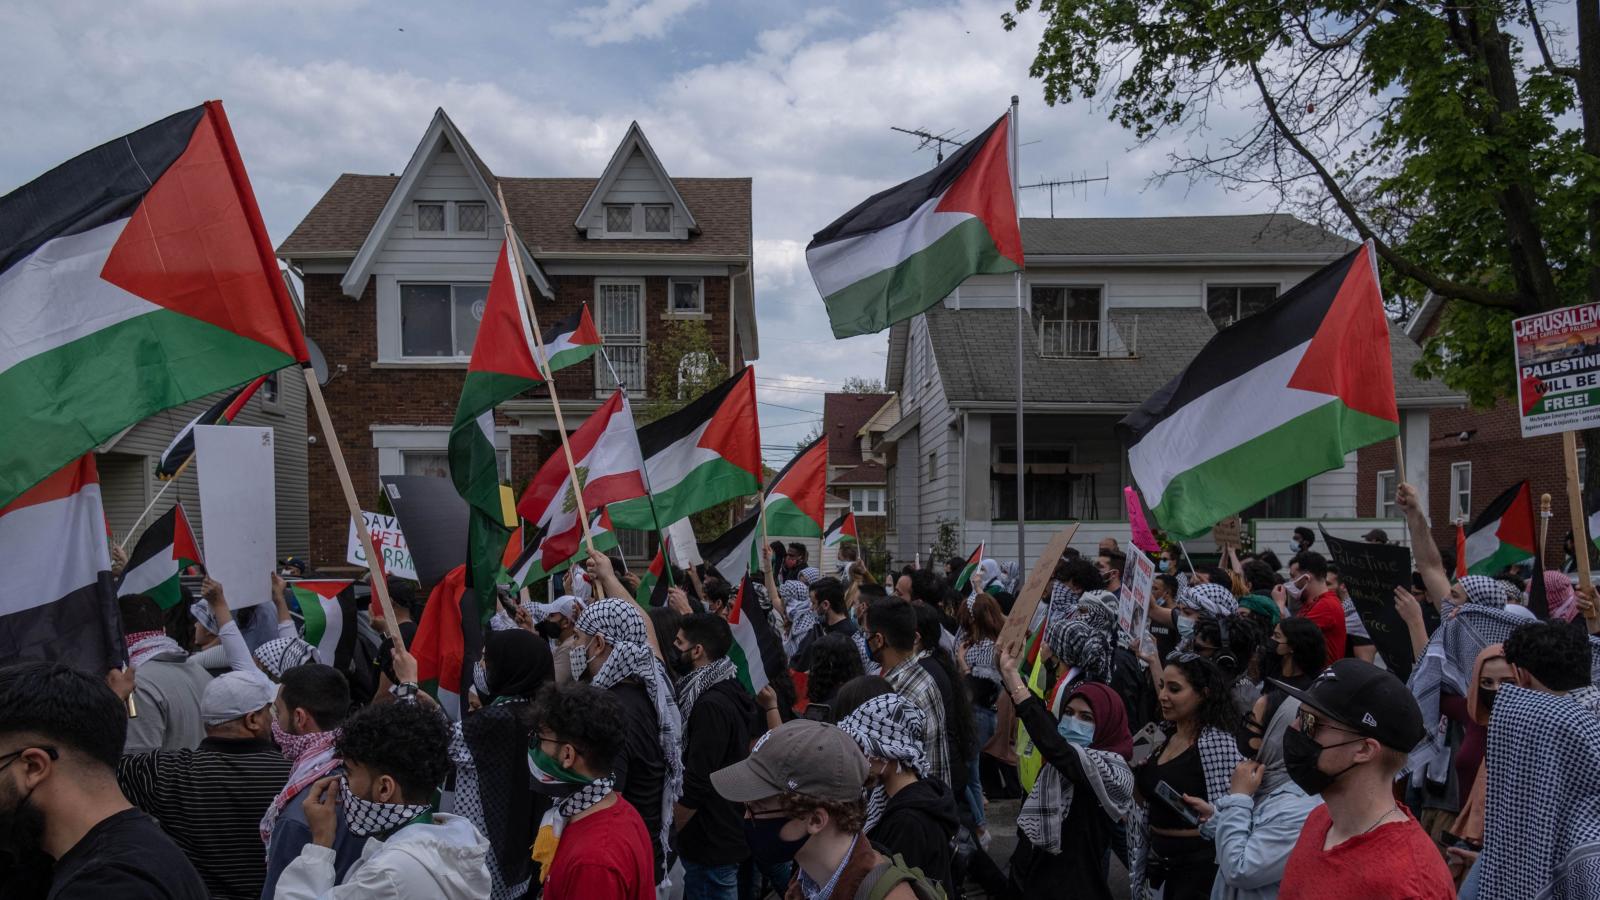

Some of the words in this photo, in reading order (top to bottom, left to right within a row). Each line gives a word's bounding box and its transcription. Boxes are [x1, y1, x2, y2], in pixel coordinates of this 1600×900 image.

[1517, 304, 1600, 337] JERUSALEM
[1540, 329, 1561, 338] CAPITAL
[1570, 321, 1598, 332] PALESTINE
[1534, 378, 1571, 394] WILL
[1576, 373, 1597, 388] BE
[1543, 393, 1589, 411] FREE!
[1329, 541, 1399, 572] Palestine
[1361, 611, 1391, 633] Free
